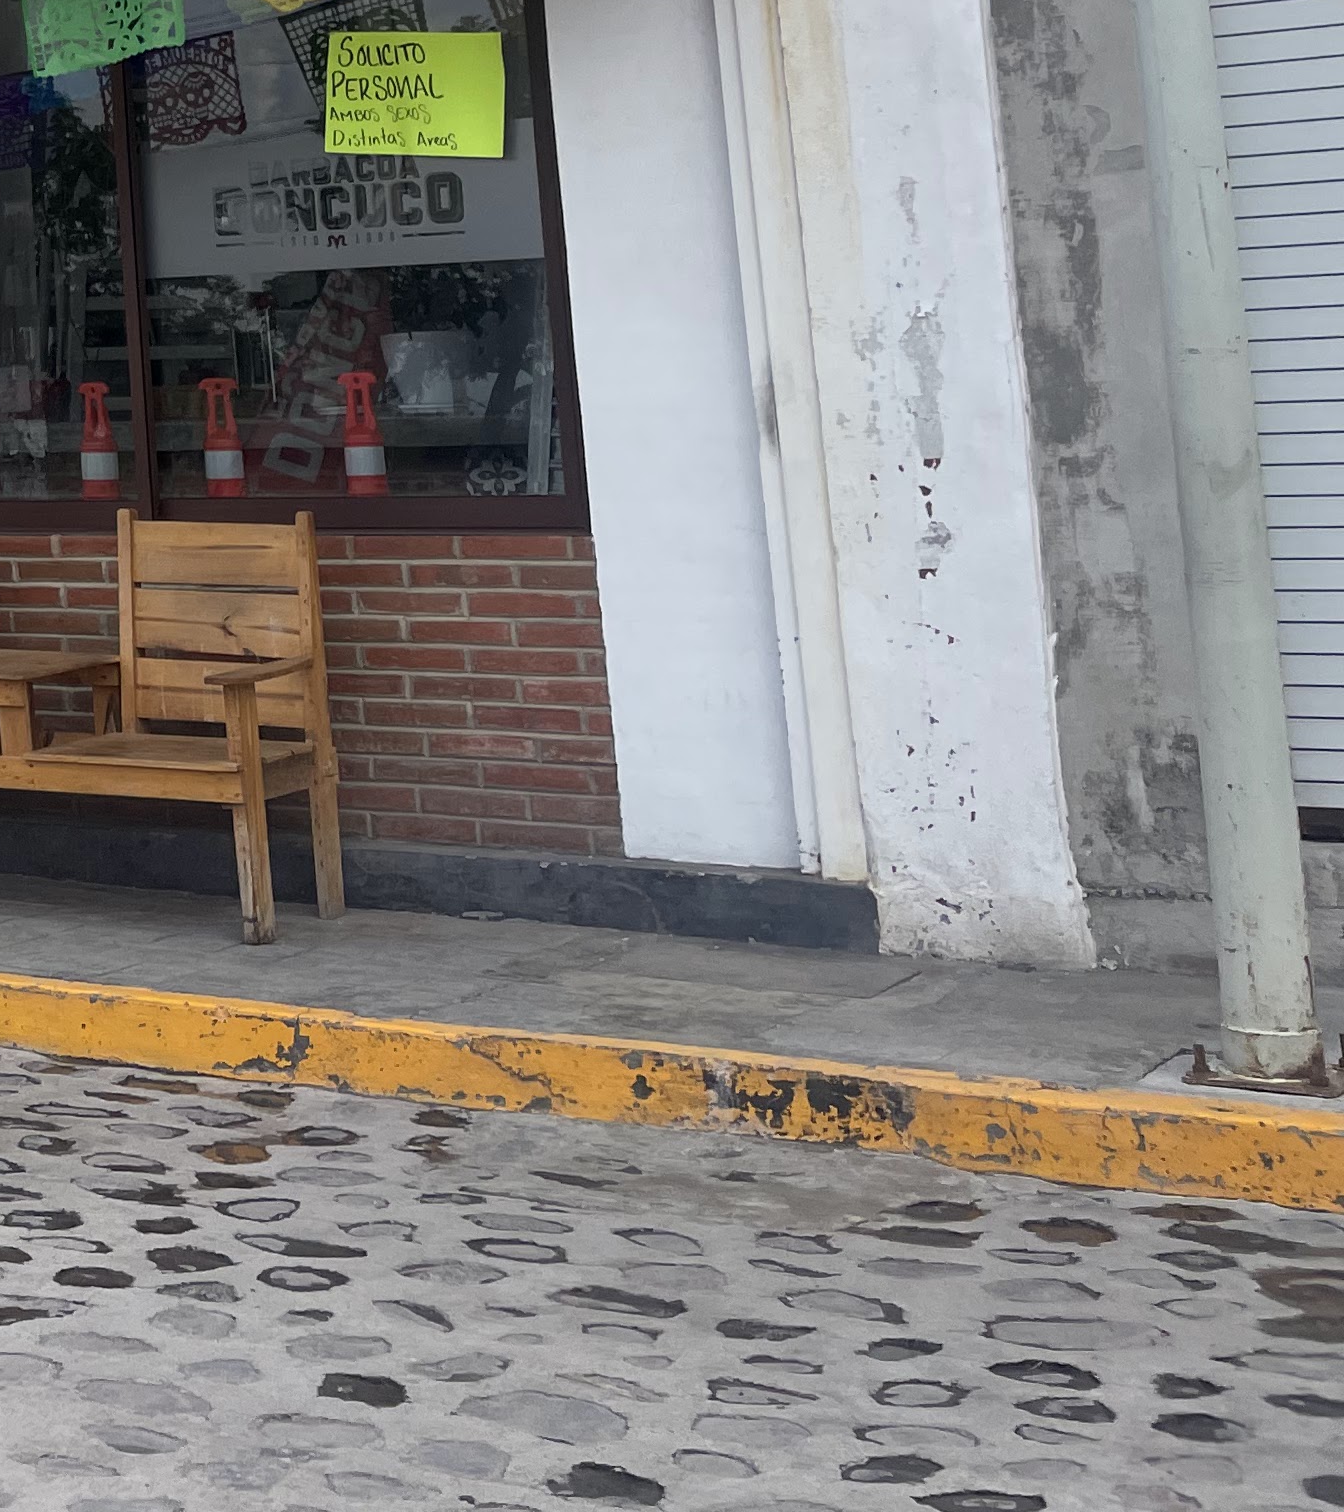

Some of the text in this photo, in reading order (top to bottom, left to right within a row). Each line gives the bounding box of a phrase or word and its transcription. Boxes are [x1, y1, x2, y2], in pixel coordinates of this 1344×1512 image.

[337, 35, 426, 68] SOLICITO
[330, 70, 444, 102] PERSONAL
[329, 106, 380, 123] AMBOS
[332, 128, 407, 148] Distintas
